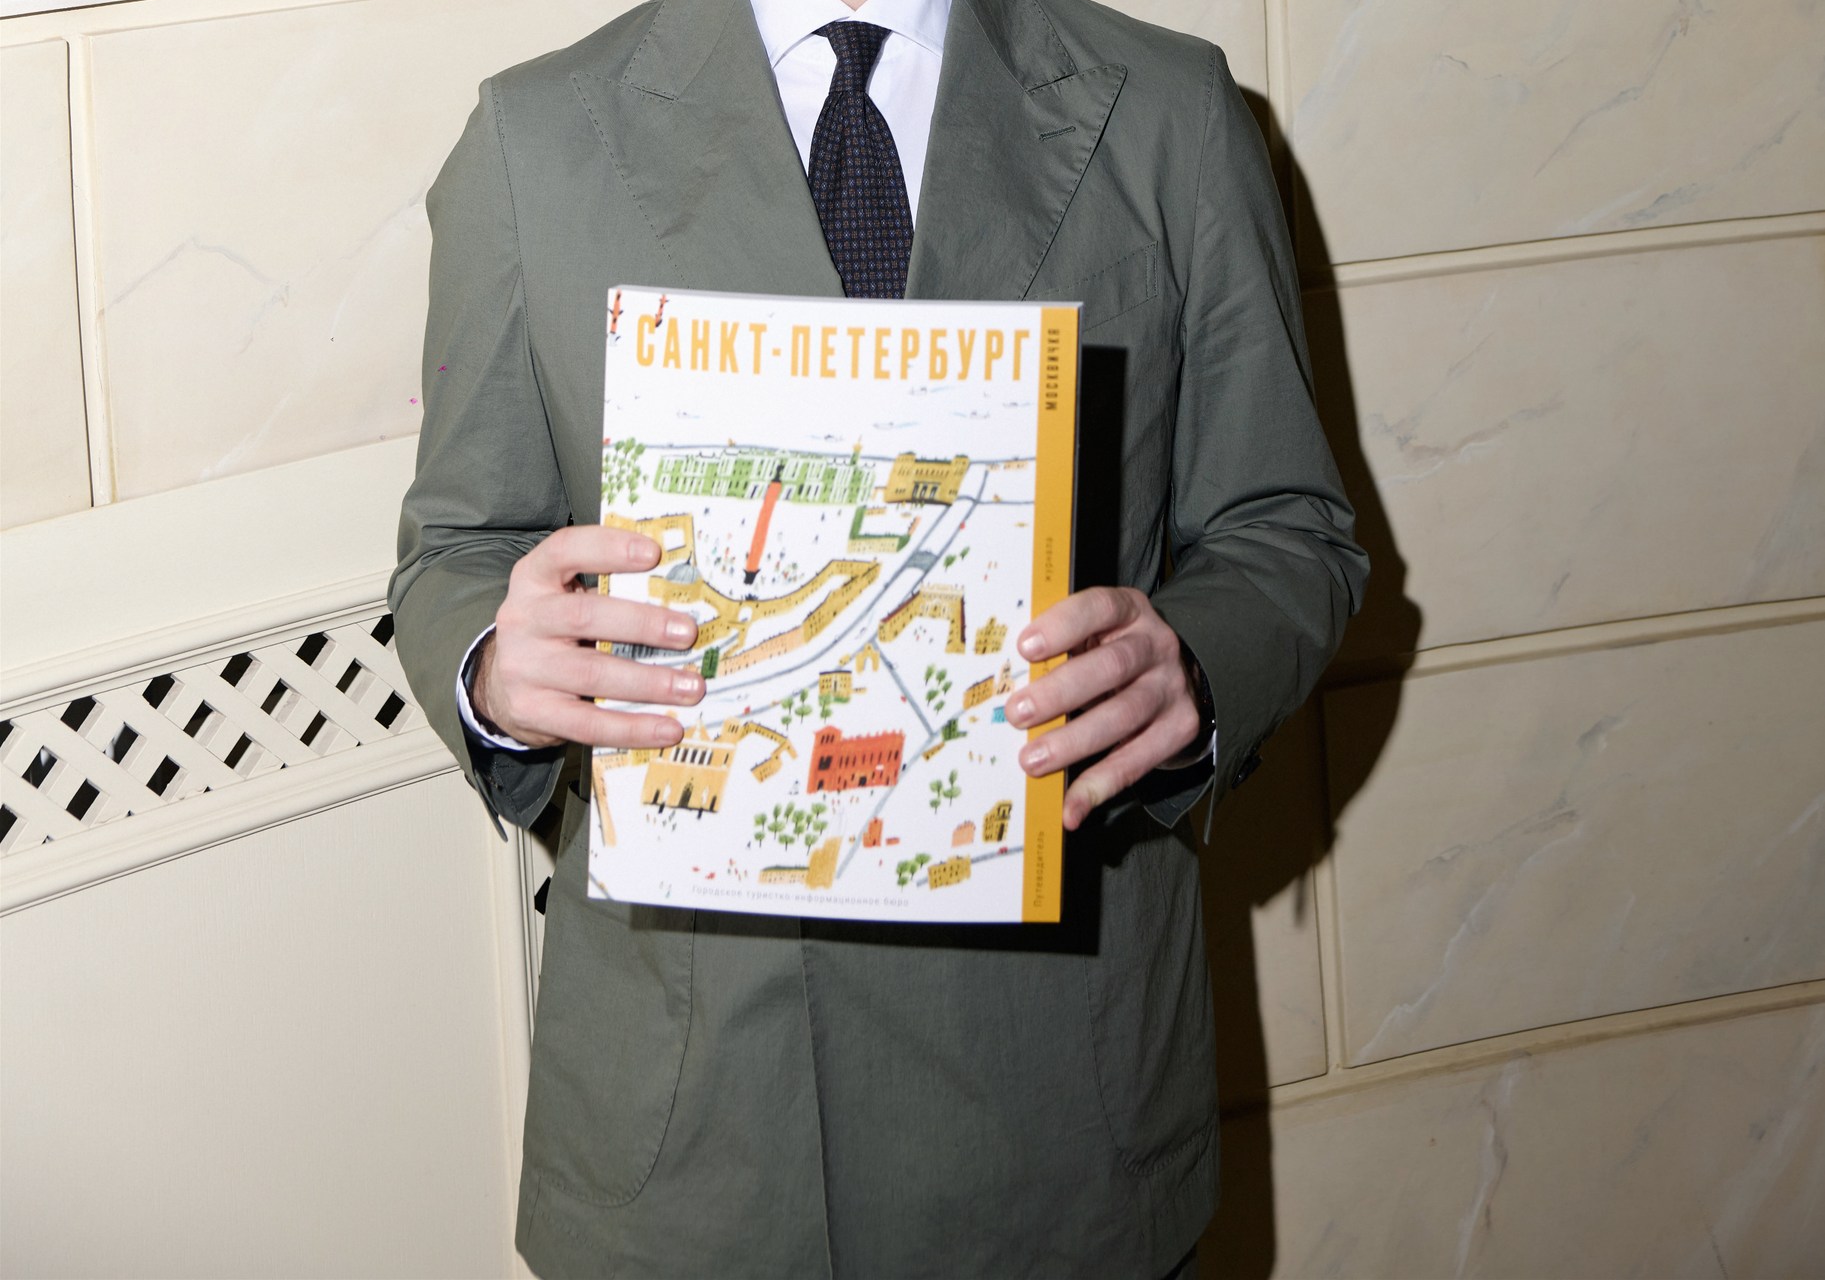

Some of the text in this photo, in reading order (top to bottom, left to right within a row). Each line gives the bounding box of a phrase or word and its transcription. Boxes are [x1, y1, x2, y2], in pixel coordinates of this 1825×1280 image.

[636, 314, 1030, 381] САНКТ-ПЕТЕРБУРГ
[692, 884, 743, 897] Городское
[883, 896, 909, 907] бюро
[1033, 831, 1045, 908] Путеводитель
